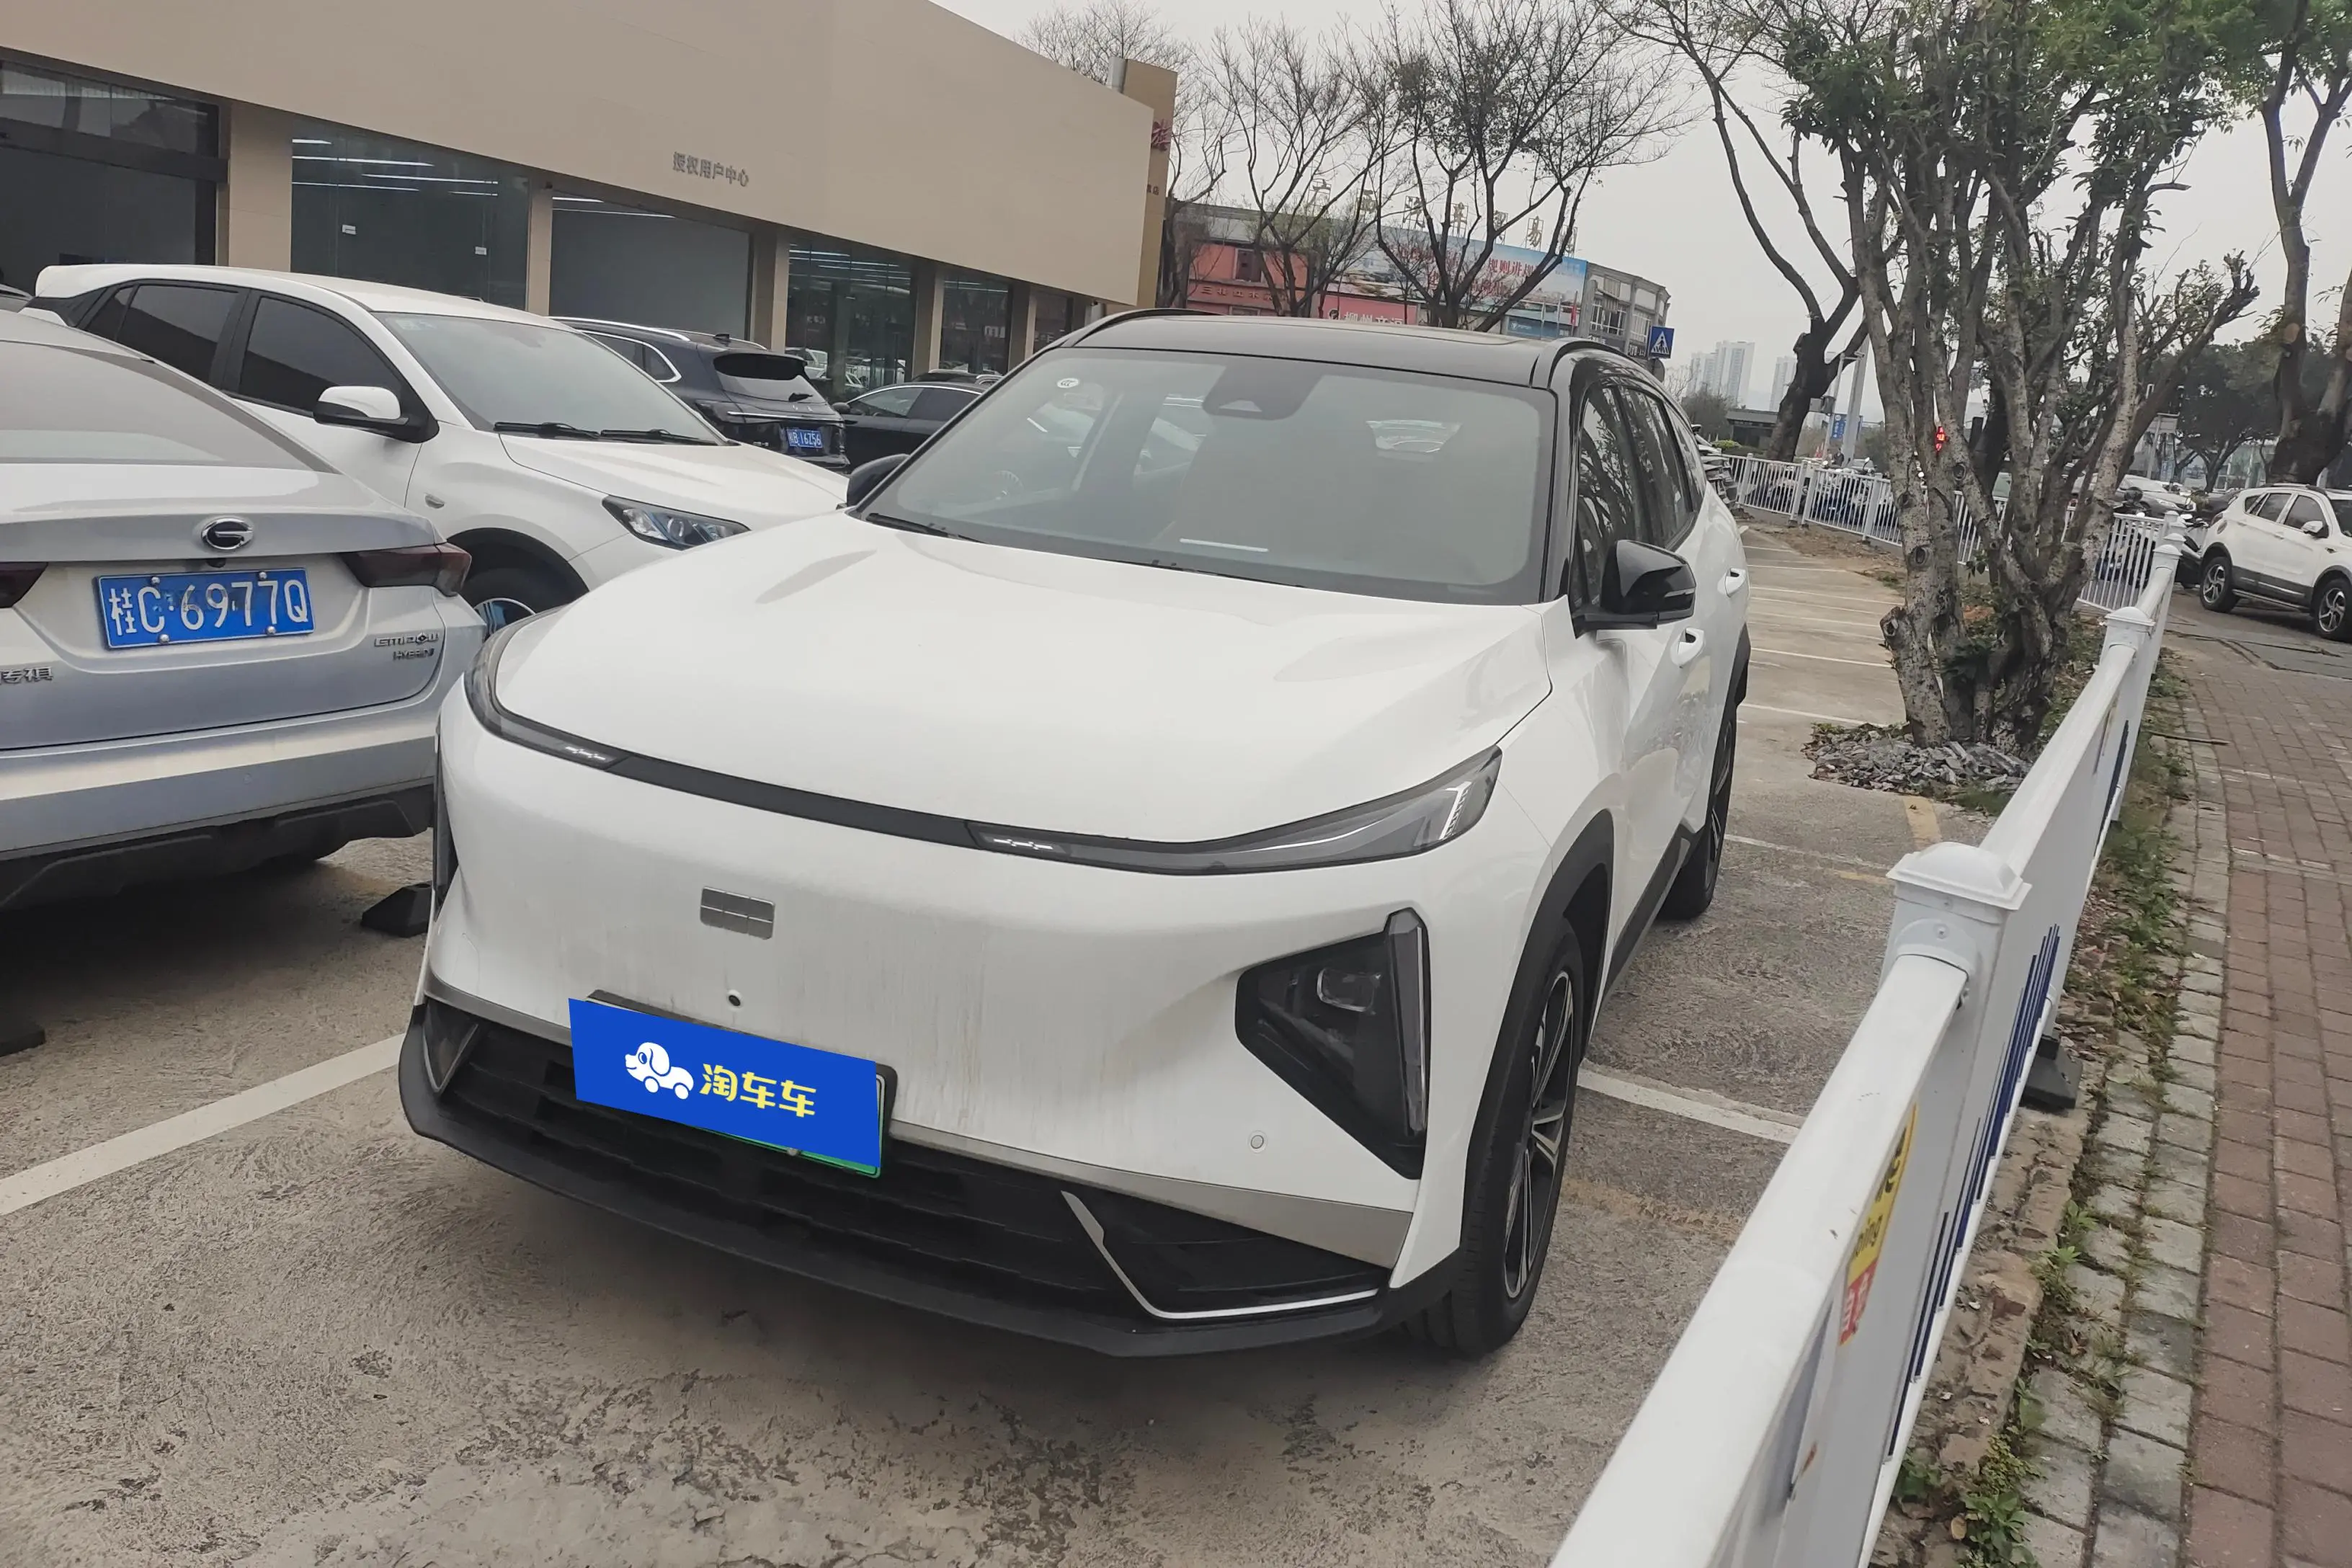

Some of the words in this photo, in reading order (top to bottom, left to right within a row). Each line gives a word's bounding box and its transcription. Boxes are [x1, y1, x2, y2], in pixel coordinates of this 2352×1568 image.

[672, 151, 749, 187] 授权用户中心
